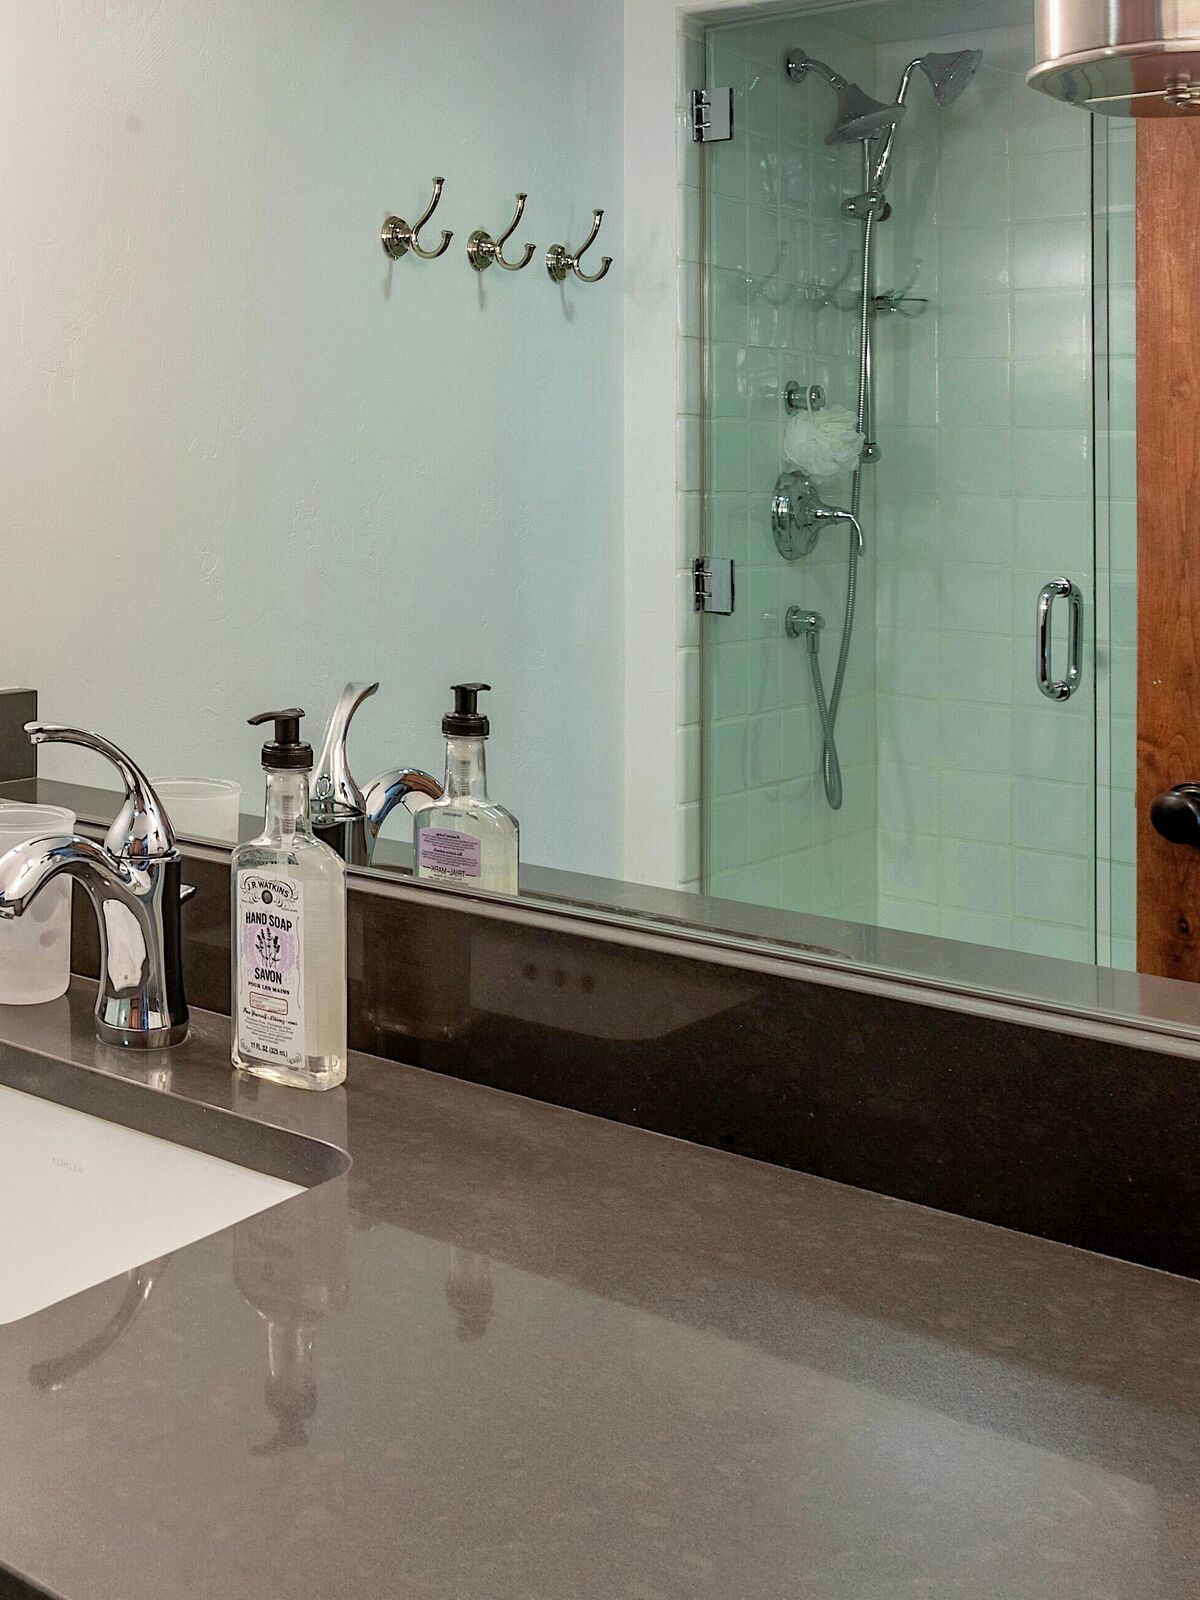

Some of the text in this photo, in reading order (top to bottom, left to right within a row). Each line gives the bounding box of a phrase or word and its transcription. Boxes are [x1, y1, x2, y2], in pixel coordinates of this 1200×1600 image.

[257, 880, 289, 898] WATKINS
[245, 911, 293, 932] HAND SOAP
[254, 967, 282, 985] SAVON
[247, 981, 290, 995] POUR LES MAINS
